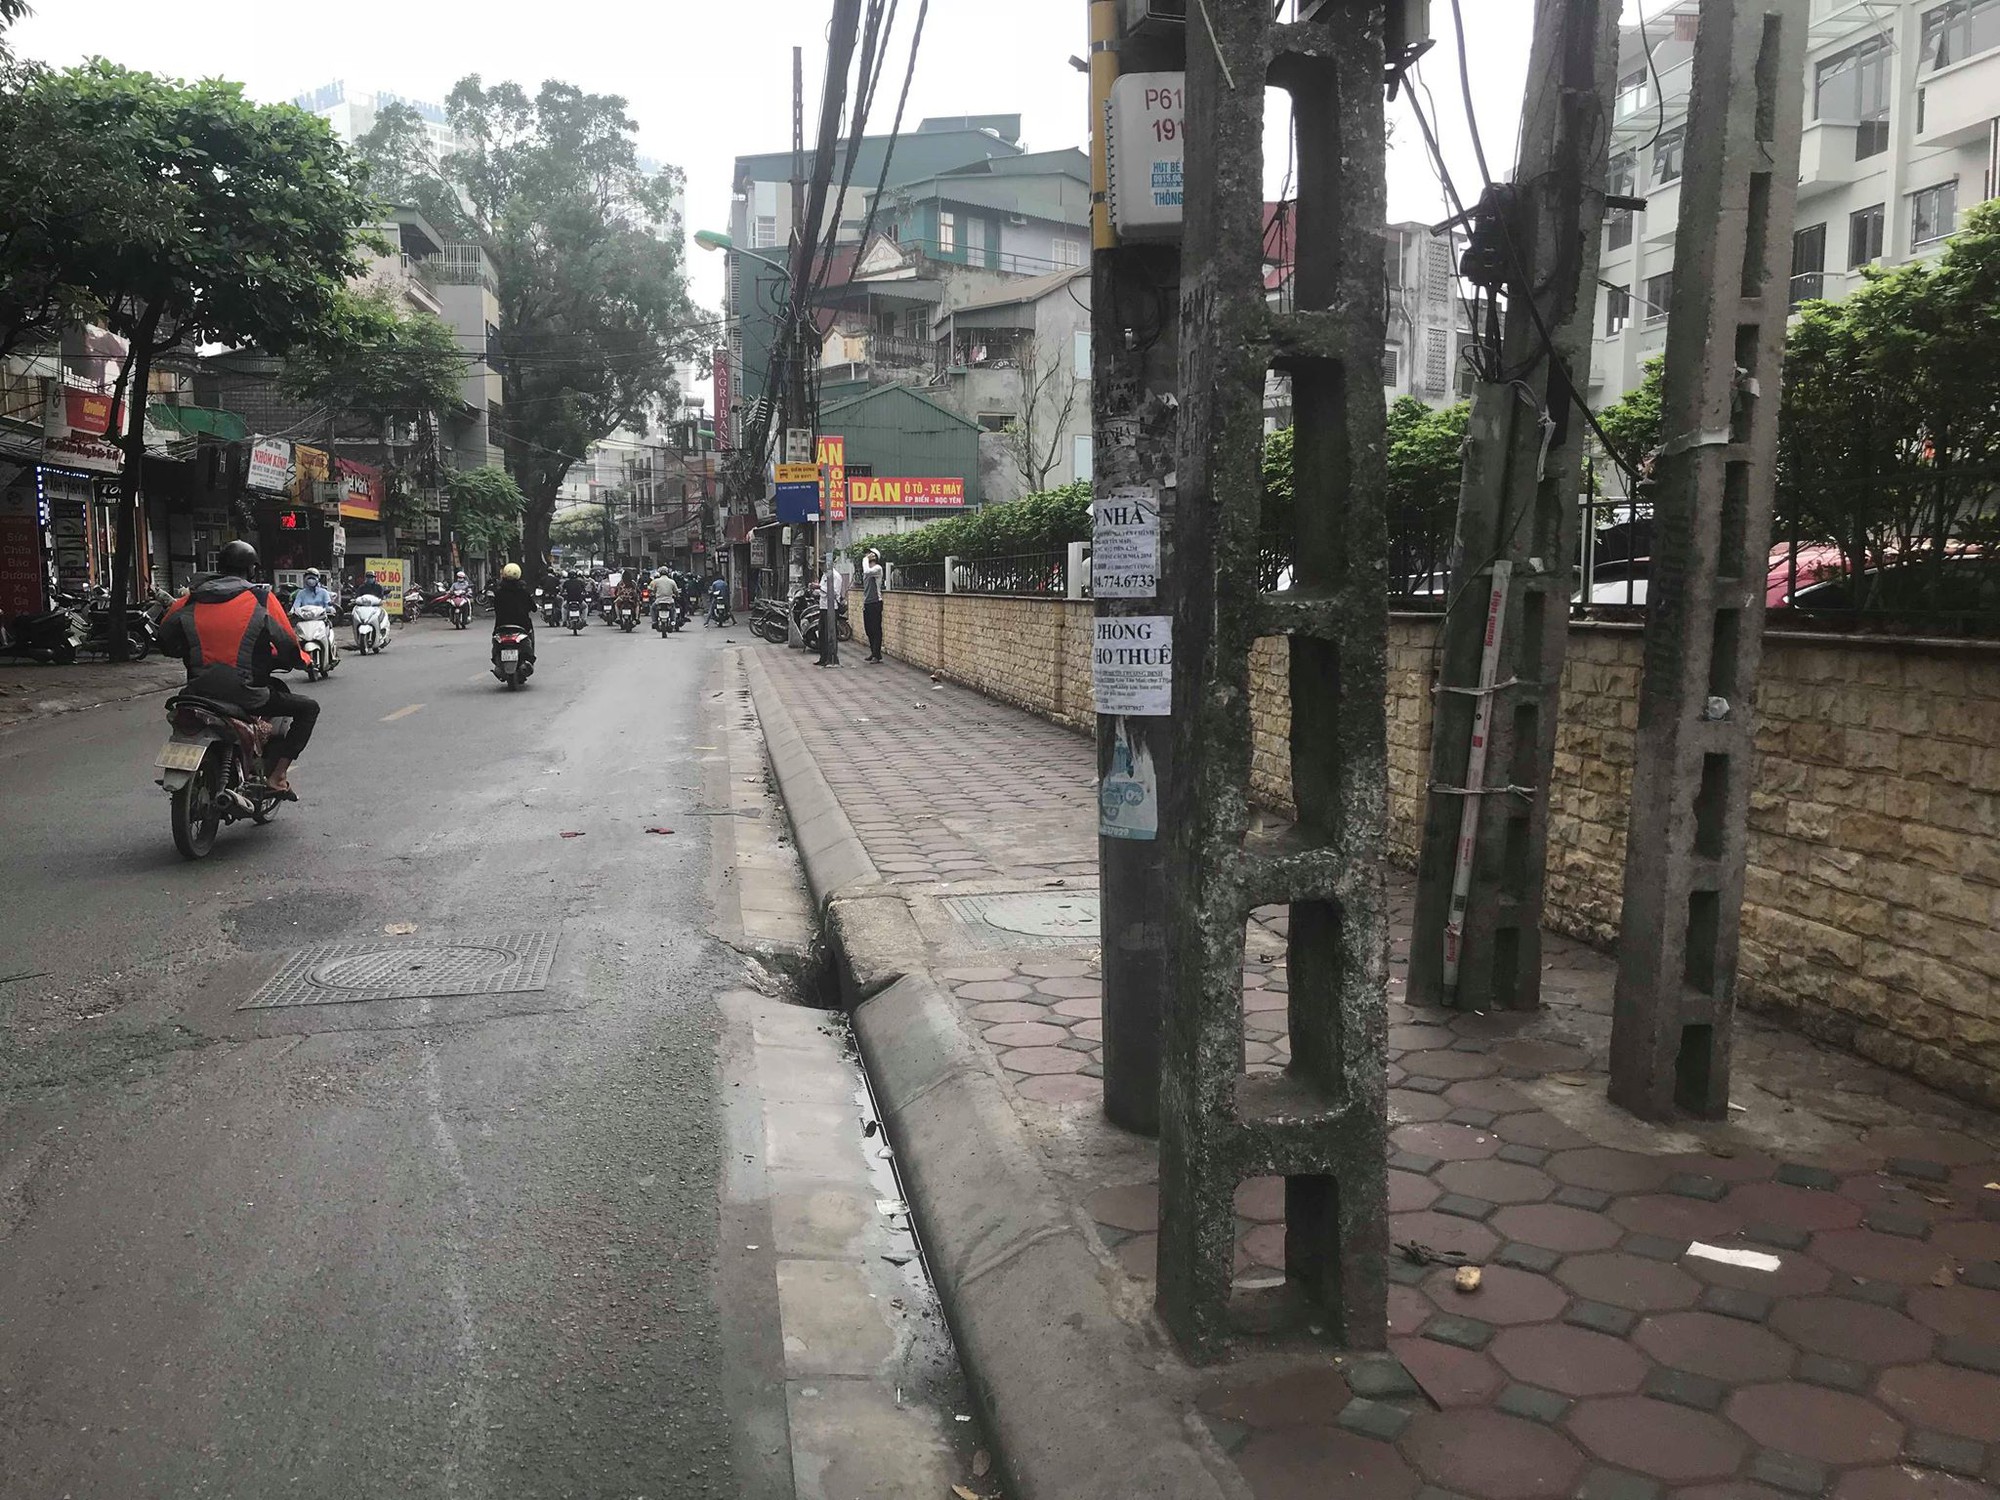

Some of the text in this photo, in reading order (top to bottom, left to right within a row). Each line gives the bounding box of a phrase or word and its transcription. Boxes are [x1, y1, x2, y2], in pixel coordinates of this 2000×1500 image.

[1145, 88, 1182, 110] P61
[1153, 188, 1184, 206] THÔNG
[718, 367, 728, 450] AGRIBANK
[852, 478, 901, 502] DÁN
[912, 482, 923, 493] TÔ
[930, 484, 941, 494] XE
[943, 482, 962, 495] MÁY
[1103, 501, 1145, 526] NHÀ
[374, 567, 401, 583] HỞ BÒ
[1095, 644, 1172, 665] HO THUÊ
